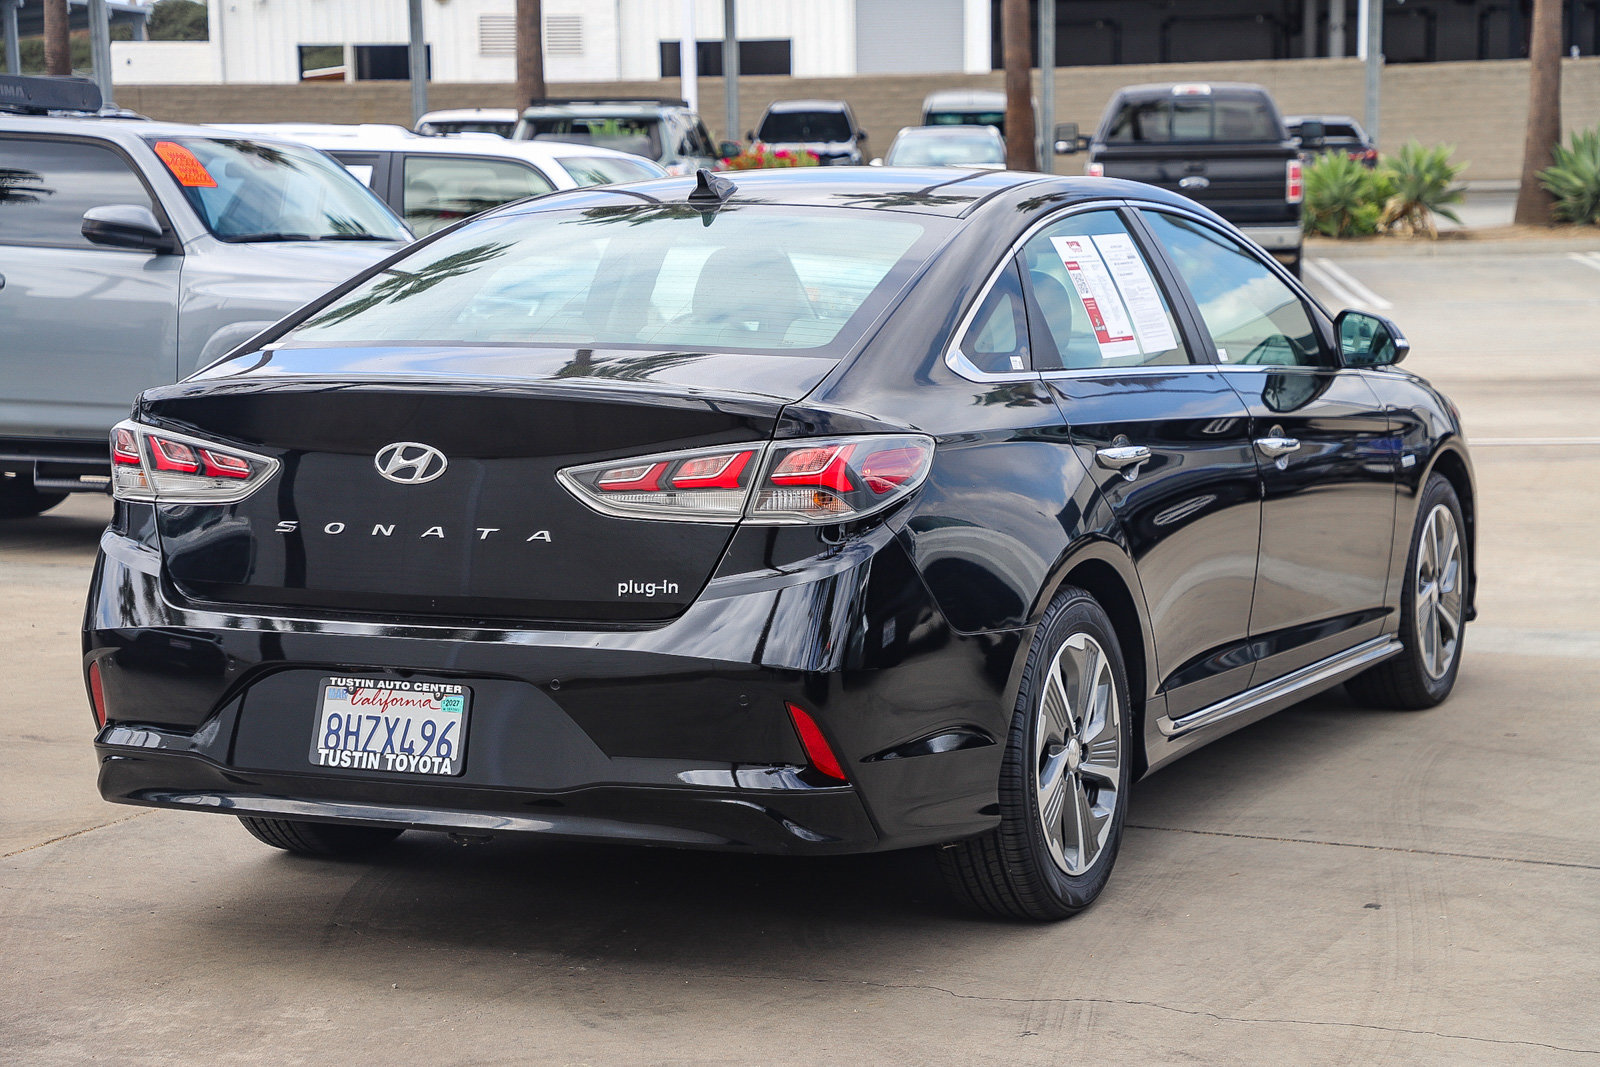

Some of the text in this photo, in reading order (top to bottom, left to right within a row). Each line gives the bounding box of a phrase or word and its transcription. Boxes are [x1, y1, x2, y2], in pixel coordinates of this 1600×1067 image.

[275, 520, 552, 542] SONATA
[618, 579, 679, 597] plug-in
[329, 677, 462, 694] TUSTIN AUTO CENTER
[351, 687, 441, 713] California
[445, 699, 460, 707] 2027
[324, 712, 457, 758] 8HZX496
[318, 748, 452, 775] TUSTIN TOYOTA
